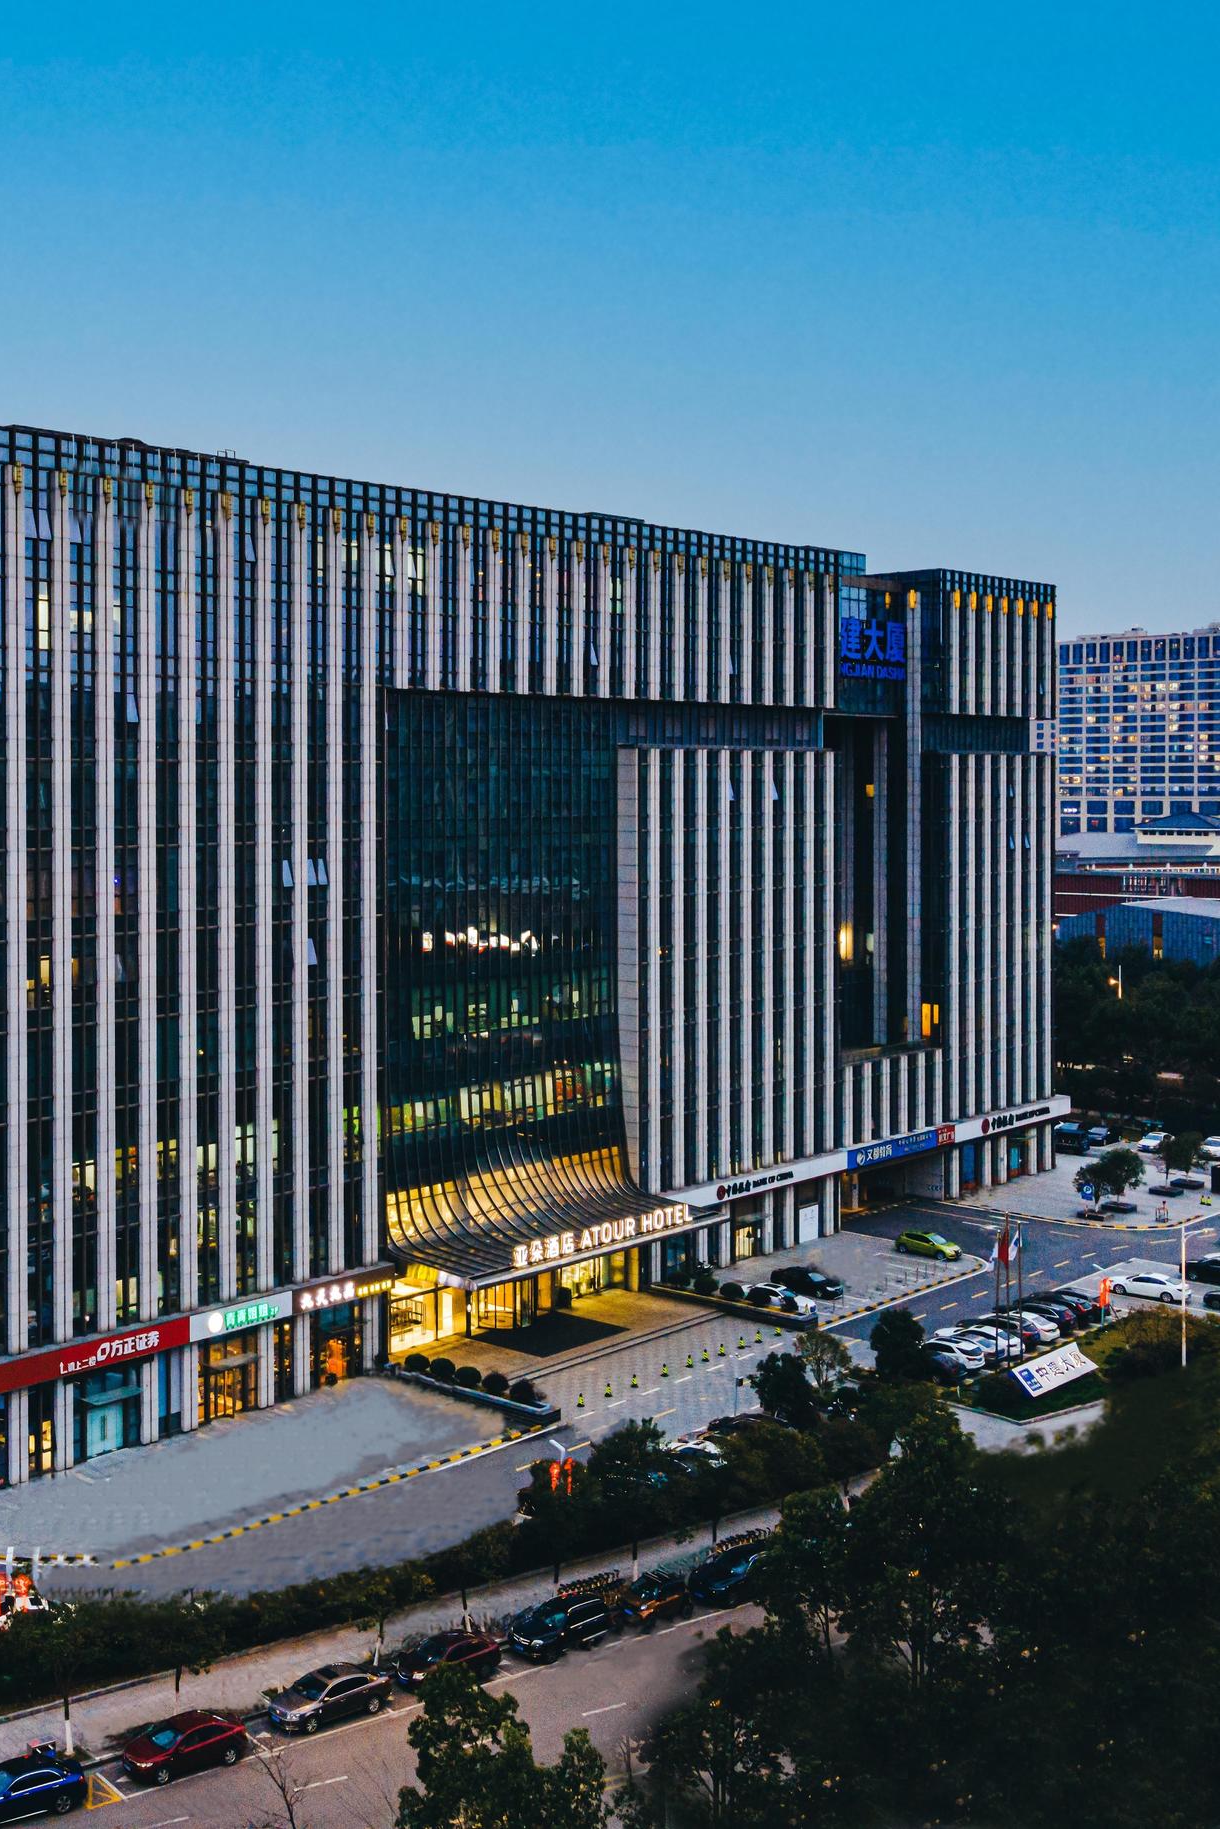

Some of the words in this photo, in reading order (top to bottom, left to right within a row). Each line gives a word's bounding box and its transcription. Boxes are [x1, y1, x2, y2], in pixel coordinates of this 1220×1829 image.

[513, 1231, 575, 1268] 亚朵酒店
[581, 1217, 636, 1249] ATOUR
[641, 1203, 693, 1233] HOTEL
[110, 1330, 160, 1358] 方正证券
